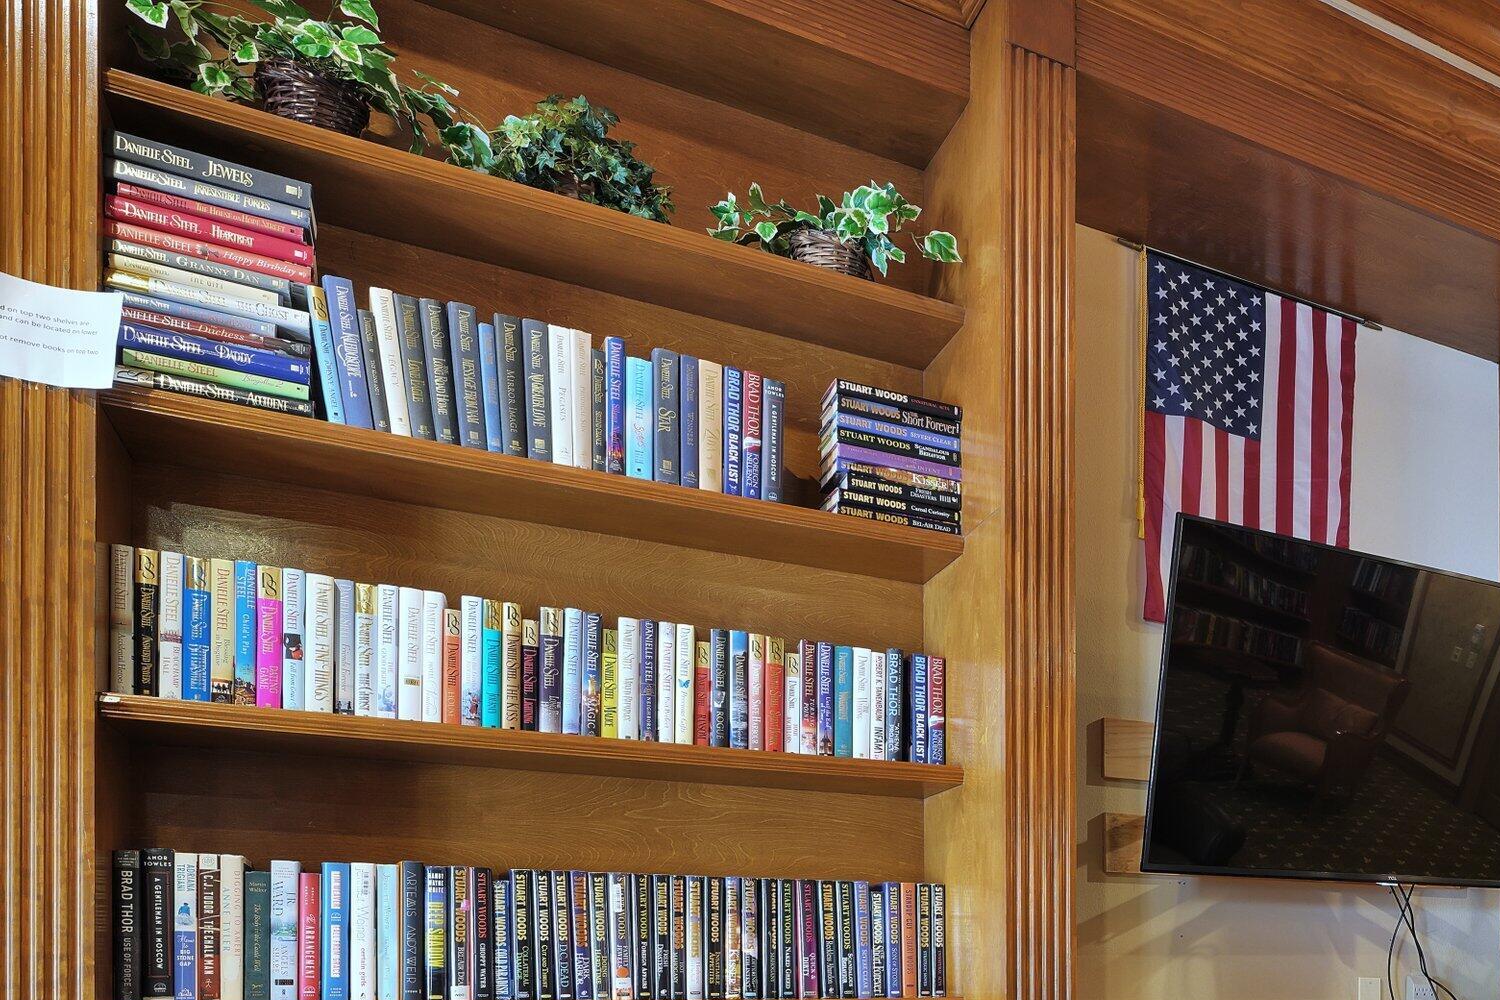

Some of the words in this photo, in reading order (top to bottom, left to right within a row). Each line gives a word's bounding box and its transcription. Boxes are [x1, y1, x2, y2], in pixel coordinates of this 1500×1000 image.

[116, 135, 161, 161] DANIELLE
[161, 149, 193, 170] STEEL
[202, 160, 253, 187] JEWELS
[116, 161, 156, 181] DANIELLE
[156, 174, 186, 189] STEEL
[194, 184, 240, 204] IRRESISTIBLE
[243, 195, 270, 210] FORCES
[124, 201, 169, 225] DANIELLE
[170, 216, 202, 234] STEEL
[211, 225, 254, 246] HEARTBEAT
[112, 223, 160, 245] DANIELLE
[163, 235, 192, 252] STEEL
[223, 251, 253, 266] Happy
[257, 259, 296, 276] Birthday
[112, 240, 149, 259] DANIELLE
[176, 256, 229, 276] GRANNY
[233, 269, 259, 284] DAN
[21, 310, 33, 318] top
[44, 324, 70, 333] located
[161, 316, 194, 330] STEEL
[197, 323, 245, 341] Duchess
[10, 337, 41, 347] remove
[43, 344, 65, 353] books
[124, 325, 171, 348] DANIELLE
[173, 336, 204, 355] STEEL
[214, 344, 255, 365] DADDY
[134, 350, 184, 371] DANIELLE
[188, 362, 218, 377] STEEL
[153, 375, 204, 396] DANIELLE
[205, 384, 239, 401] STEEL
[246, 392, 288, 411] ACCIDENT
[728, 370, 740, 400] BRAD
[749, 374, 760, 403] BRAD
[840, 381, 872, 395] STUART
[875, 389, 908, 403] WOODS
[658, 407, 676, 432] STAR
[728, 403, 739, 431] THOR
[748, 405, 760, 436] THOR
[841, 398, 870, 412] STUART
[871, 404, 901, 419] WOODS
[902, 411, 925, 427] Short
[926, 416, 956, 434] Forever
[840, 415, 872, 429] STUART
[875, 422, 908, 436] WOODS
[910, 432, 931, 441] SEVERE
[932, 436, 951, 446] CLEAR
[840, 430, 876, 443] STUART
[877, 436, 910, 450] WOODS
[729, 432, 739, 463] BLACK
[729, 464, 738, 484] LIST
[841, 461, 873, 473] STUART
[875, 467, 910, 482] WOODS
[912, 473, 947, 488] KISSER
[852, 478, 876, 490] STUART
[878, 482, 902, 494] WOODS
[844, 492, 874, 504] STUART
[876, 498, 906, 510] WOODS
[841, 506, 873, 519] STUART
[876, 512, 908, 525] WOODS
[587, 614, 599, 649] DANIELLE
[587, 650, 599, 671] STEEL
[889, 653, 899, 683] BRAD
[915, 657, 925, 684] BRAD
[933, 658, 943, 687] BRAD
[506, 702, 516, 722] KISS
[889, 686, 898, 716] THOR
[915, 686, 925, 711] THOR
[933, 688, 943, 714] THOR
[716, 711, 724, 740] ROGUE
[915, 713, 925, 741] BLACK
[916, 742, 924, 761] LIST
[121, 870, 133, 900] BRAD
[539, 875, 547, 908] STUART
[557, 875, 566, 909] STUART
[203, 891, 214, 914] TUDOR
[935, 886, 943, 918] STUART
[121, 904, 133, 933] THOR
[155, 926, 162, 934] IN
[539, 909, 549, 941] WOODS
[558, 909, 568, 941] WOODS
[784, 915, 792, 944] WOODS
[123, 937, 131, 951] USE
[203, 932, 214, 957] CHALK
[935, 919, 943, 948] WOODS
[123, 952, 131, 962] OF
[154, 936, 163, 970] MOSCOW
[429, 928, 444, 969] SHADOW
[123, 963, 131, 987] FORCE
[203, 958, 214, 975] MAN
[560, 961, 569, 988] DEAD
